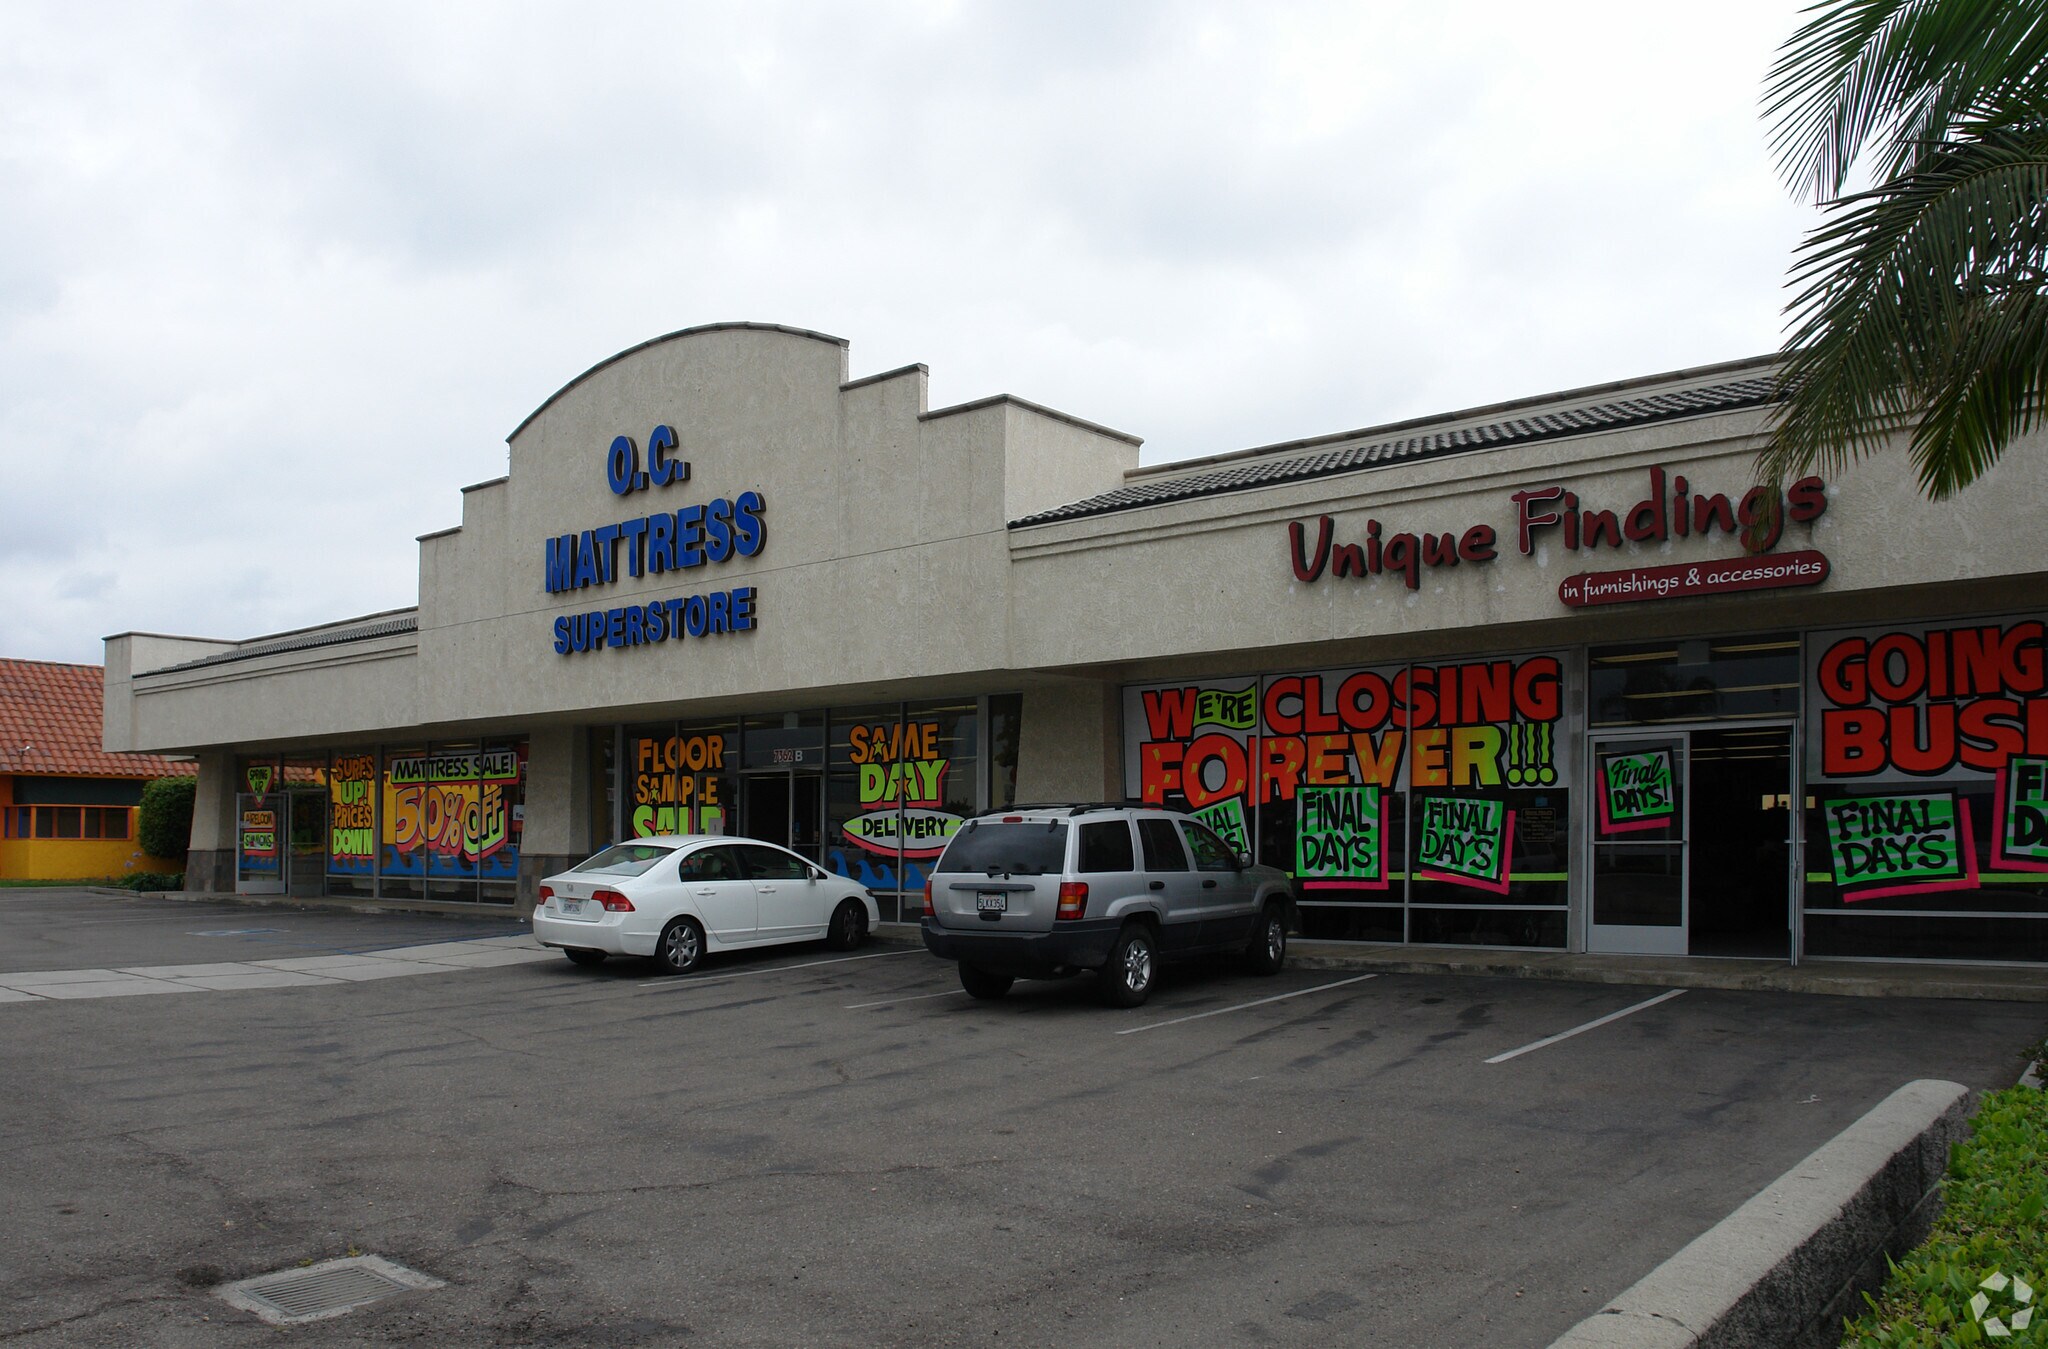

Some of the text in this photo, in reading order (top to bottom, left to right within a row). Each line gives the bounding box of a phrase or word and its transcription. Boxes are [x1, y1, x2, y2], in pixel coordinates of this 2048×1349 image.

[607, 425, 691, 495] O.C.
[545, 491, 767, 593] MATTRESS
[1288, 464, 1828, 590] Unique Findings
[1564, 558, 1822, 603] in furnishings & accessories
[554, 587, 757, 655] SUPERSTORE
[1818, 620, 2046, 707] GOING
[1263, 658, 1564, 736] CLOSING
[637, 734, 725, 774] FLOOR
[794, 750, 803, 762] B
[849, 721, 940, 764] SAME
[394, 753, 514, 780] MATTRESS SALE!
[858, 759, 949, 808] DAY
[1610, 754, 1665, 787] Final
[341, 780, 369, 806] UP!
[1613, 777, 1670, 814] DAYS!
[333, 804, 373, 829] PRICES
[395, 785, 504, 849] 50% OFF
[1427, 801, 1499, 837] FINAL
[1831, 798, 1952, 841] FINAL
[332, 827, 374, 857] DOWN
[1301, 836, 1371, 873] DAYS
[1424, 829, 1494, 871] DAYS
[1837, 834, 1951, 877] DAYS
